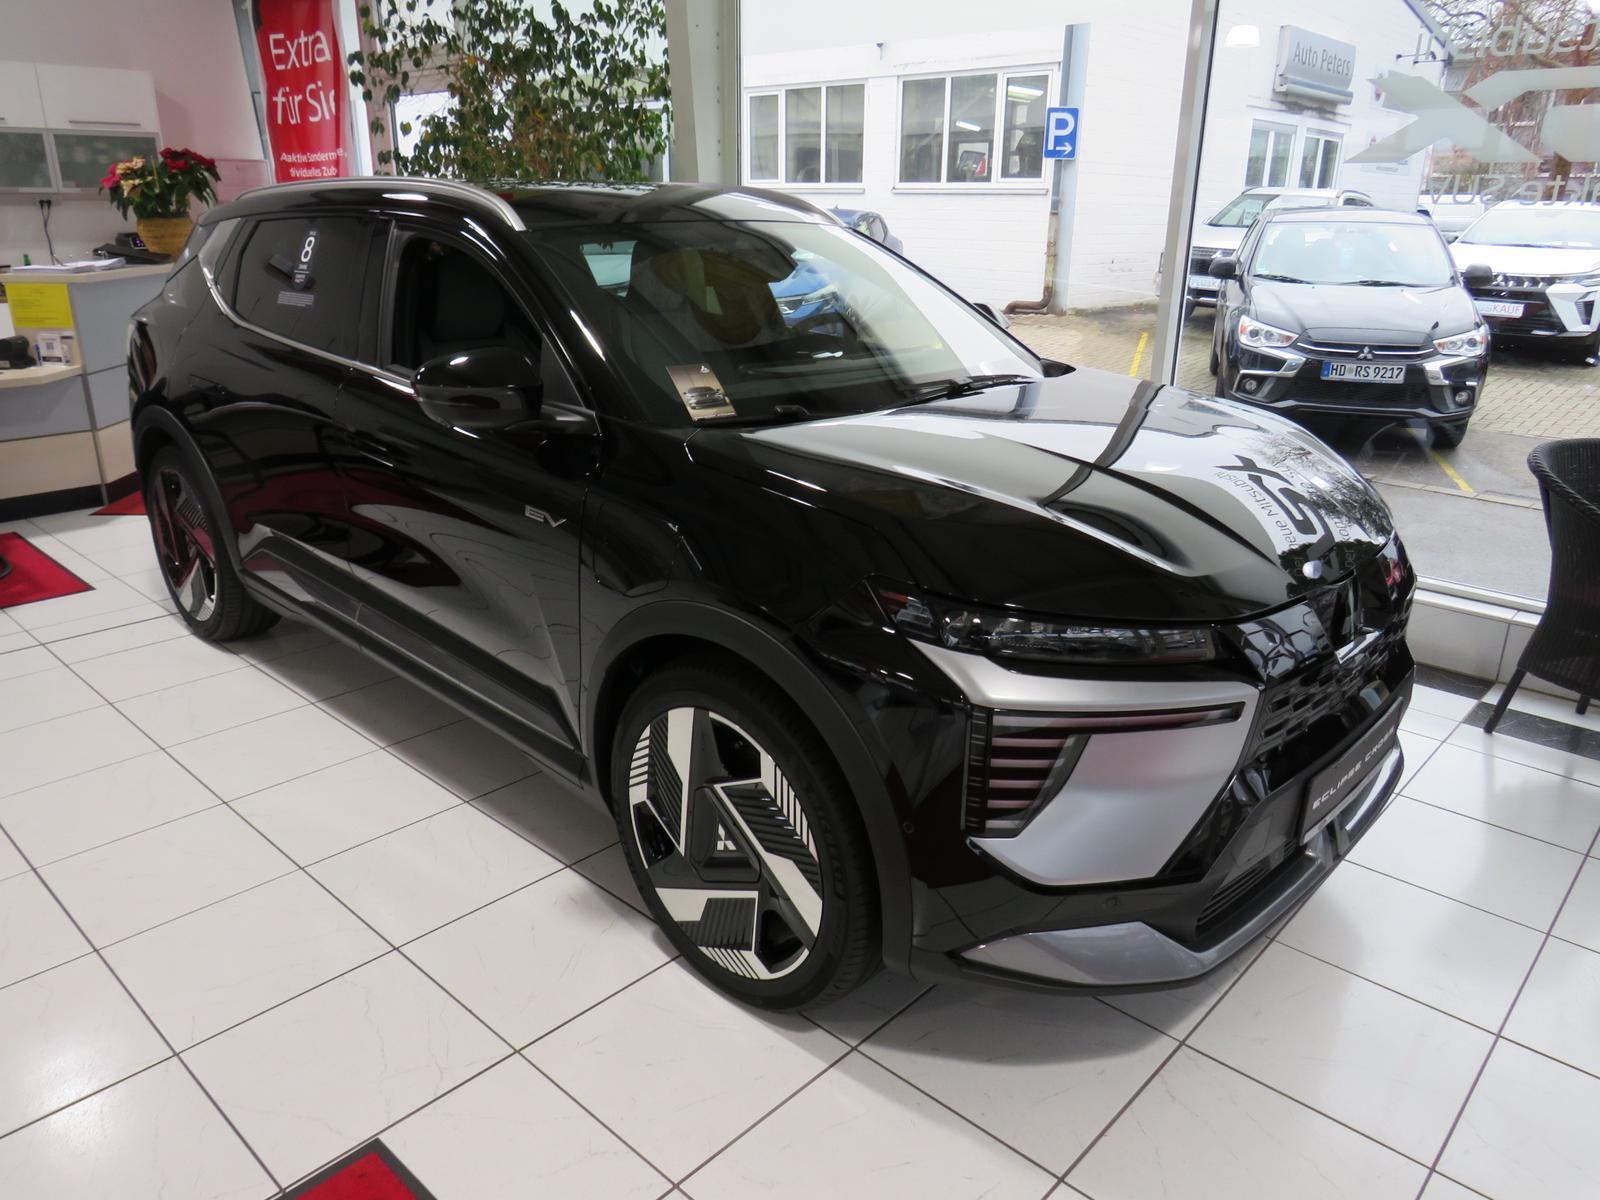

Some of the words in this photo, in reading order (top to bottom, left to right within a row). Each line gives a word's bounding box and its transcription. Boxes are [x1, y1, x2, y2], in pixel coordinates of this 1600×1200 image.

[269, 30, 332, 71] Extra
[1292, 41, 1318, 68] Auto
[1319, 48, 1351, 76] Peters
[272, 86, 303, 126] für
[1047, 112, 1075, 151] P
[301, 236, 316, 263] 8
[1330, 363, 1347, 377] HD
[1354, 365, 1371, 379] RS
[1373, 366, 1404, 379] 9217
[524, 504, 567, 528] EV
[1311, 760, 1362, 811] ECLIPSE
